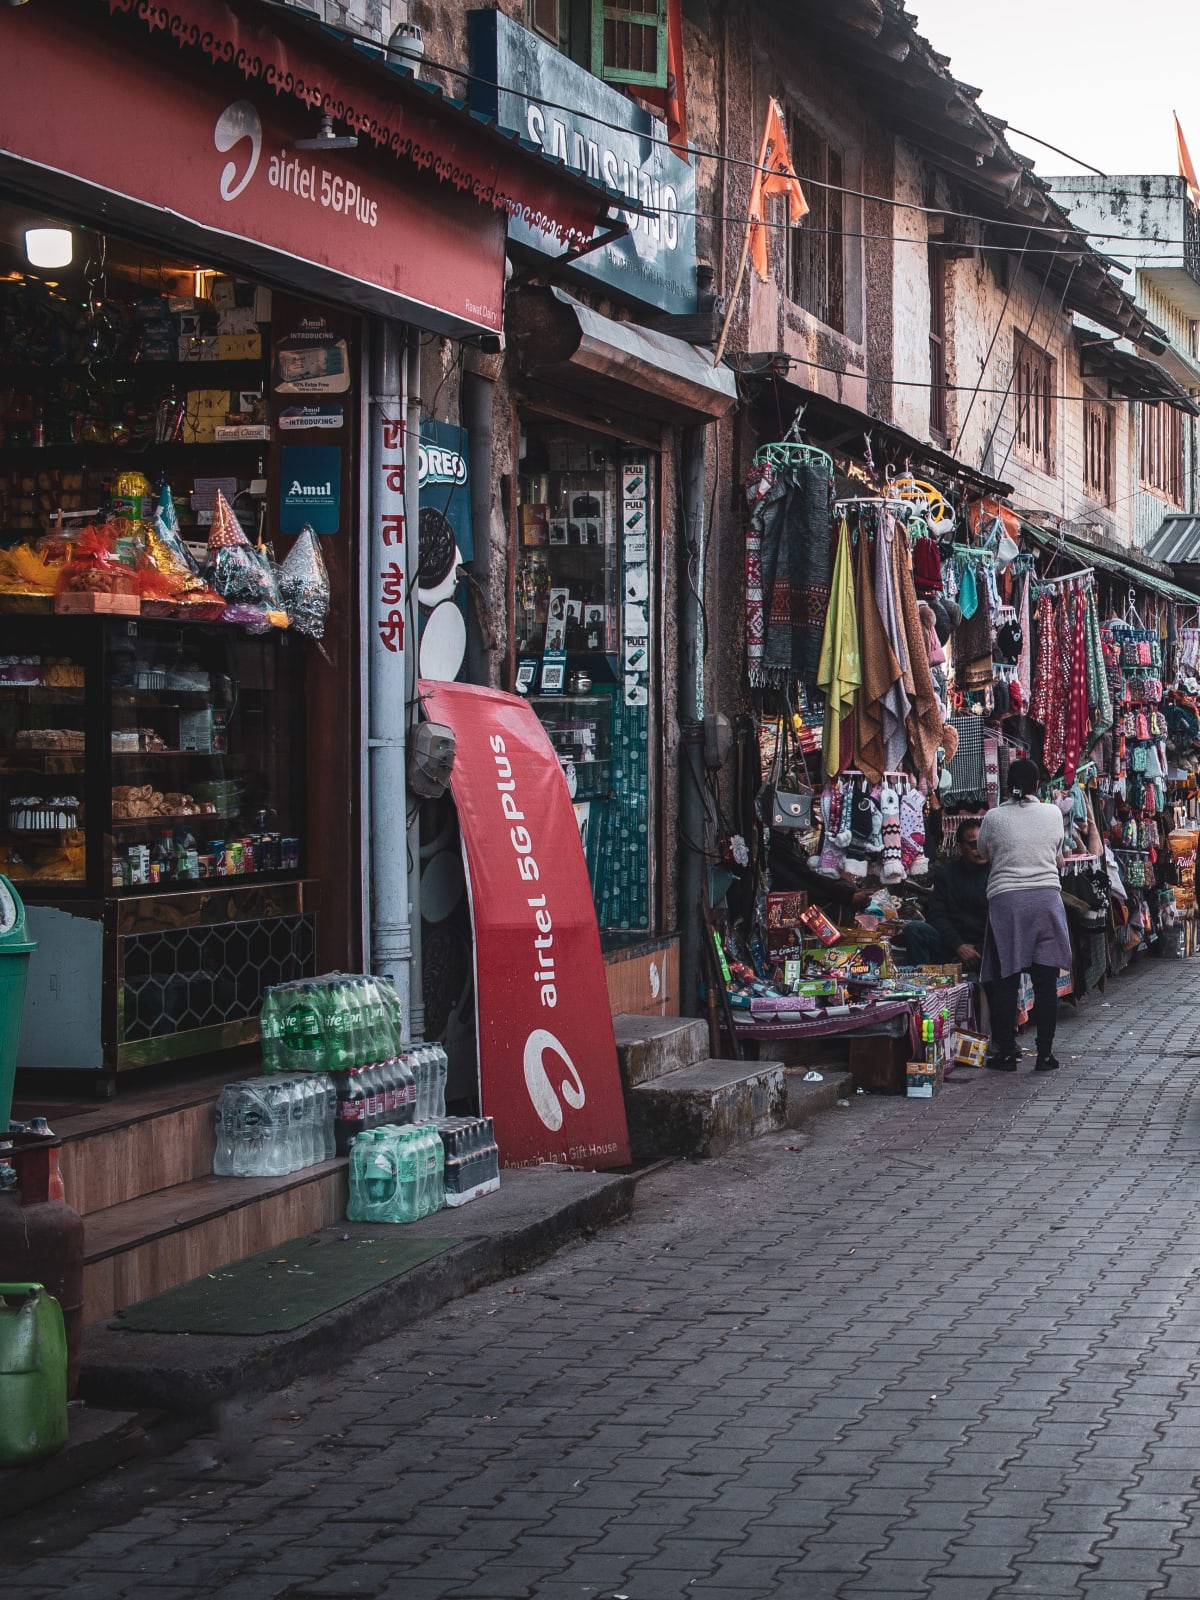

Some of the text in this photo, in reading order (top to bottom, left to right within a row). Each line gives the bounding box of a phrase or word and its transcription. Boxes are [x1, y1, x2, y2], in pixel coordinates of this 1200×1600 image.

[268, 148, 315, 202] airtel
[288, 480, 331, 497] Amul
[528, 893, 558, 1008] airtel
[569, 1144, 587, 1160] Gift
[589, 1142, 618, 1157] House
